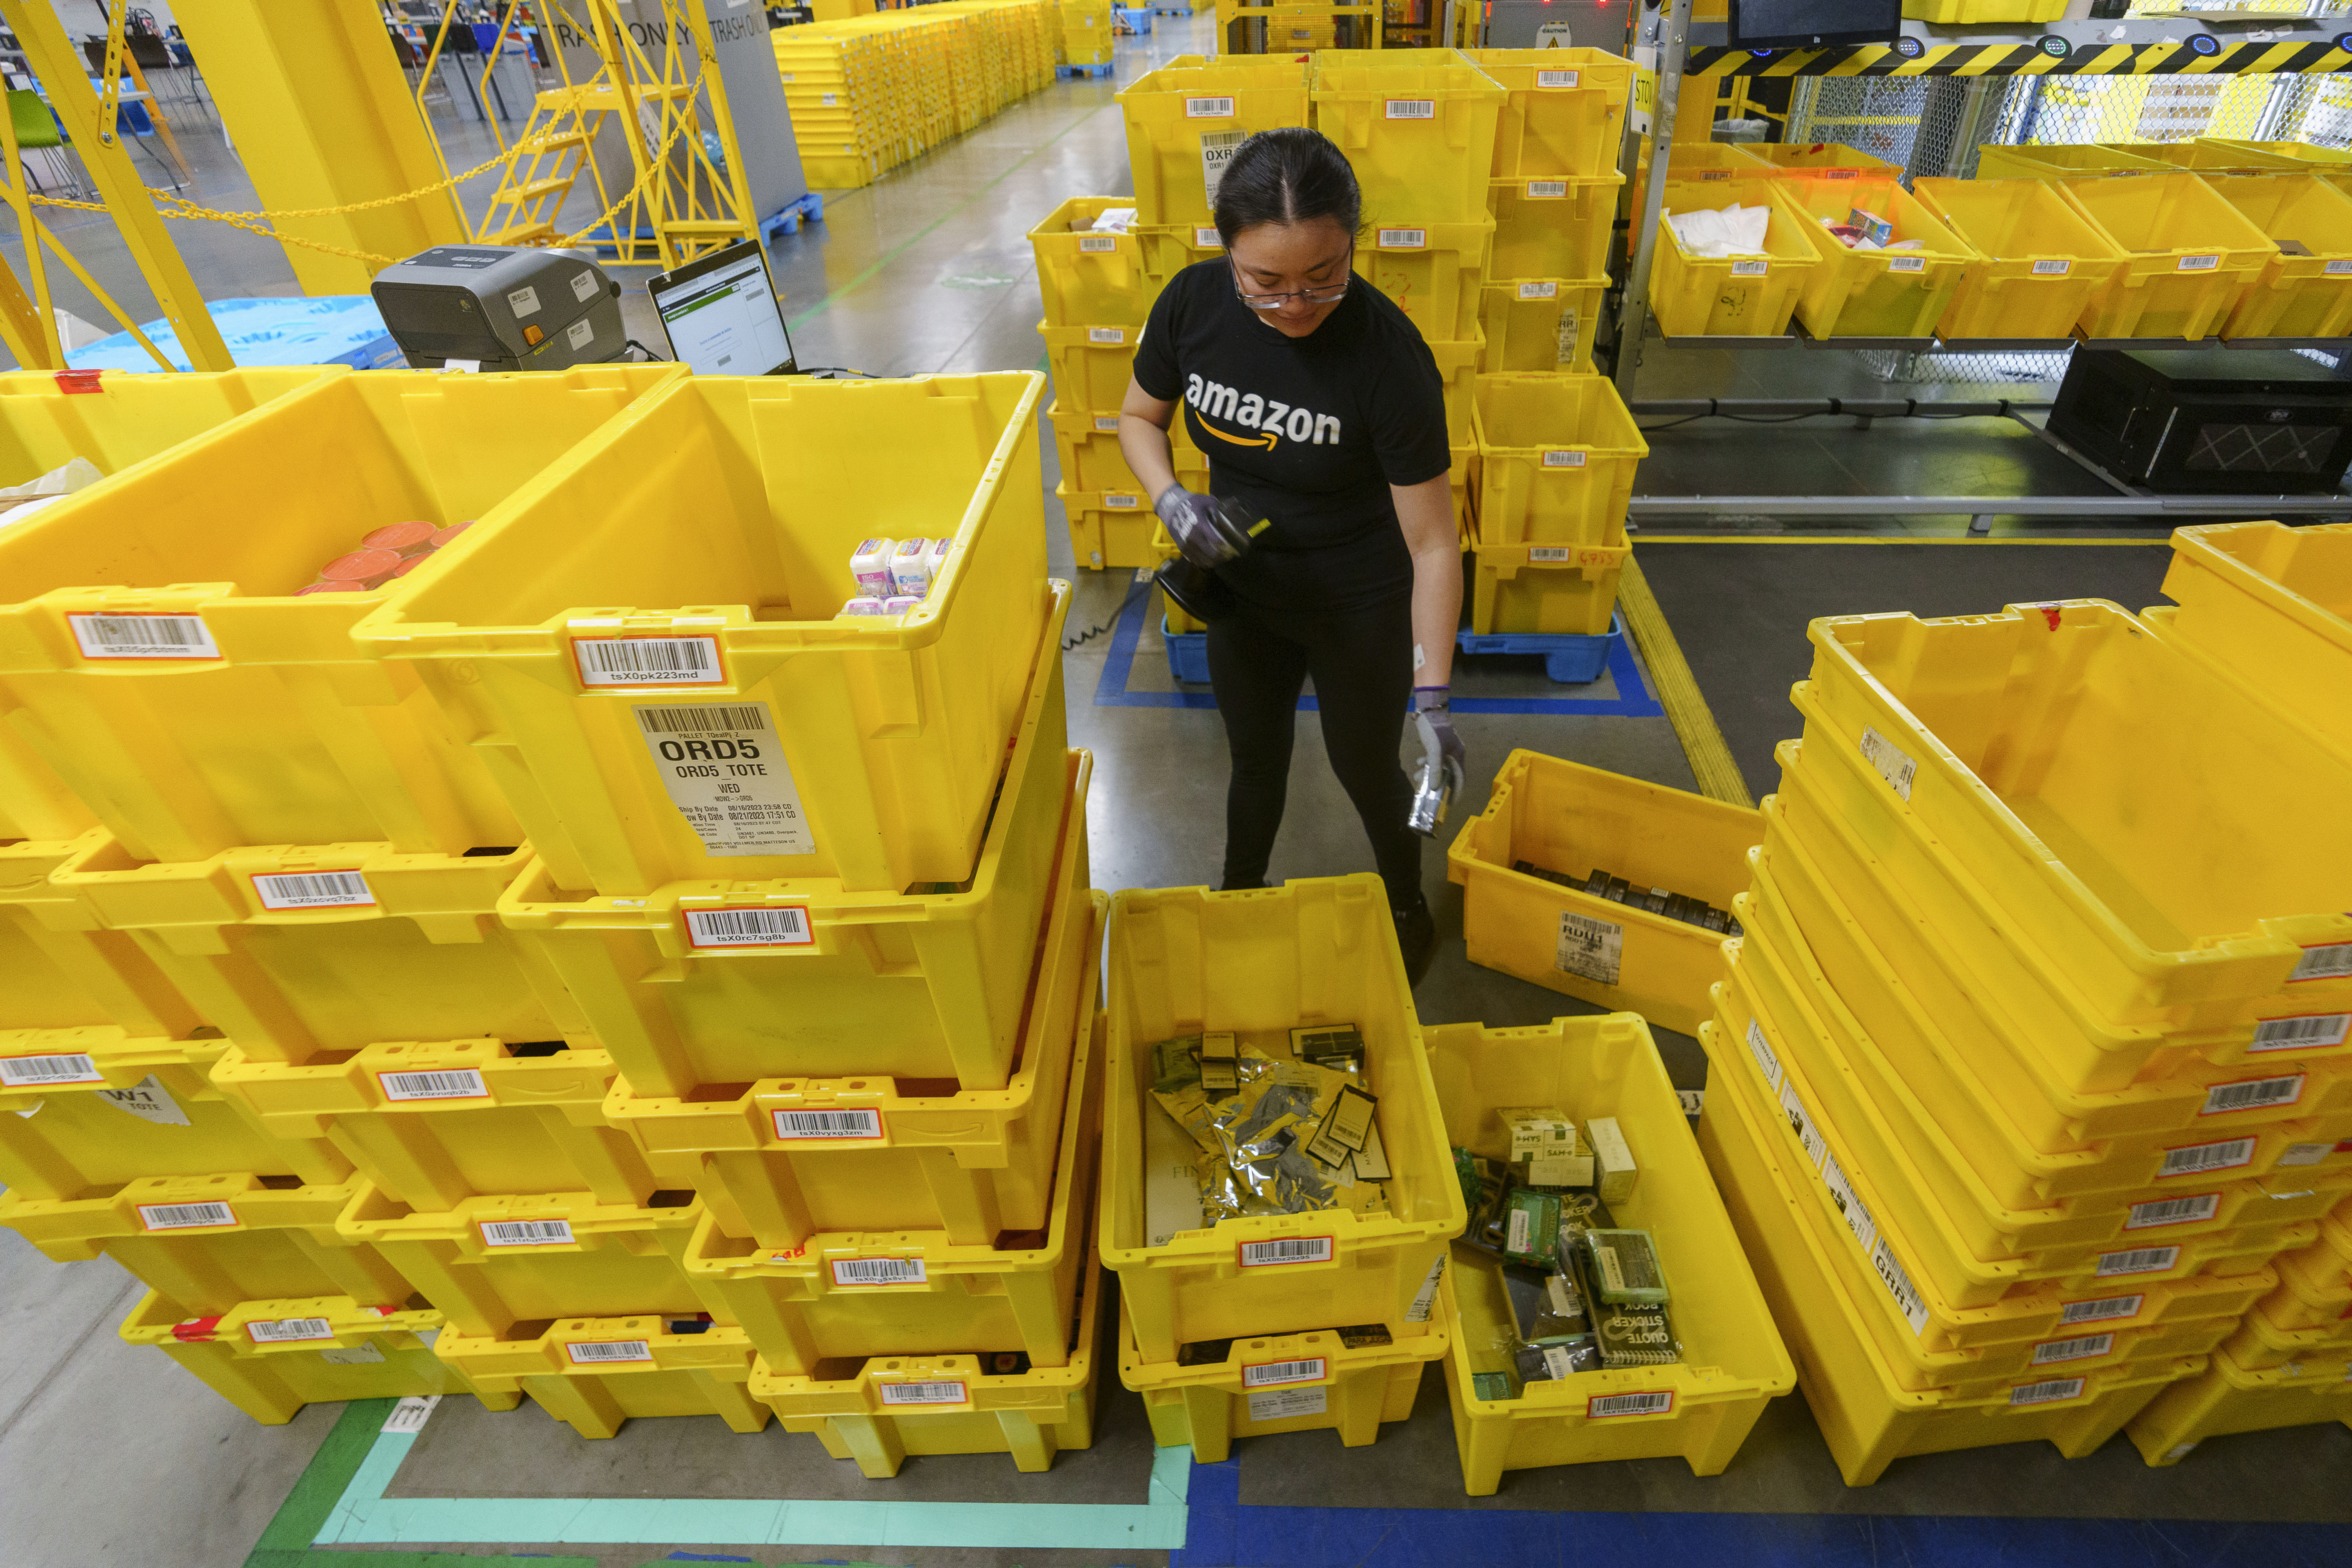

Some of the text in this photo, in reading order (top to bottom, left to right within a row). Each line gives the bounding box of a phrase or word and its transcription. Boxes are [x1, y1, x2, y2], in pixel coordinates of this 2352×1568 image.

[1635, 80, 1651, 105] STO
[1206, 149, 1236, 161] OXR
[1186, 373, 1341, 445] amazon
[611, 671, 698, 681] tsX0pk223md
[659, 739, 760, 761] ORD5
[718, 784, 740, 793] WED
[728, 812, 765, 820] 08/21/2023
[1877, 1256, 1912, 1317] GRR1
[1612, 1316, 1664, 1327] STICKER
[1628, 1333, 1669, 1344] QUOTE
